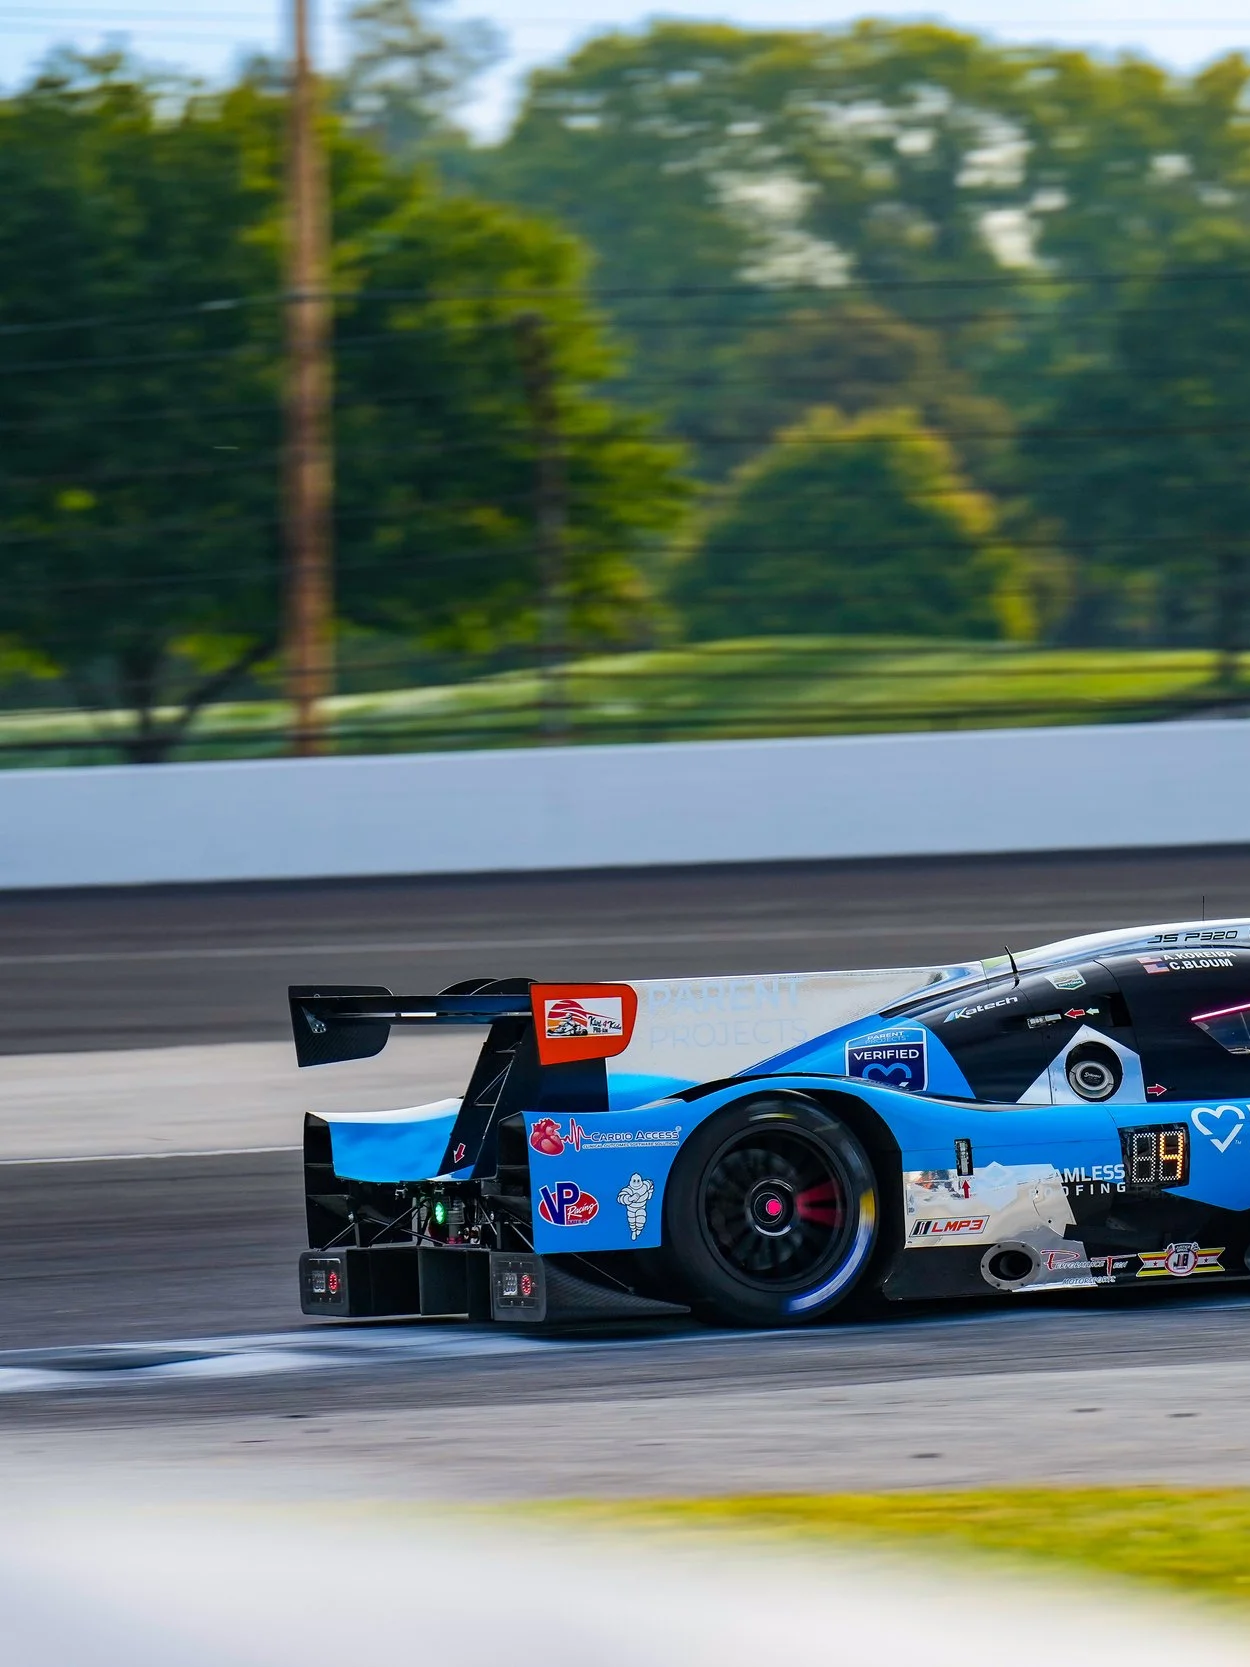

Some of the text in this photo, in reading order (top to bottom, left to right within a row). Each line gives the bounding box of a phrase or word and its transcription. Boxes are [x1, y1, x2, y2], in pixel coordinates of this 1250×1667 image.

[1185, 930, 1238, 941] P320
[1169, 958, 1234, 971] C.BLOUM
[648, 977, 802, 1014] PARENT
[954, 996, 1018, 1018] Katech
[650, 1018, 808, 1049] PROJECTS
[853, 1049, 920, 1061] VERIFIED
[591, 1131, 634, 1143] CARDIO
[1052, 1163, 1126, 1183] AMLESS
[539, 1181, 581, 1226] VP
[931, 1219, 984, 1233] LMP3
